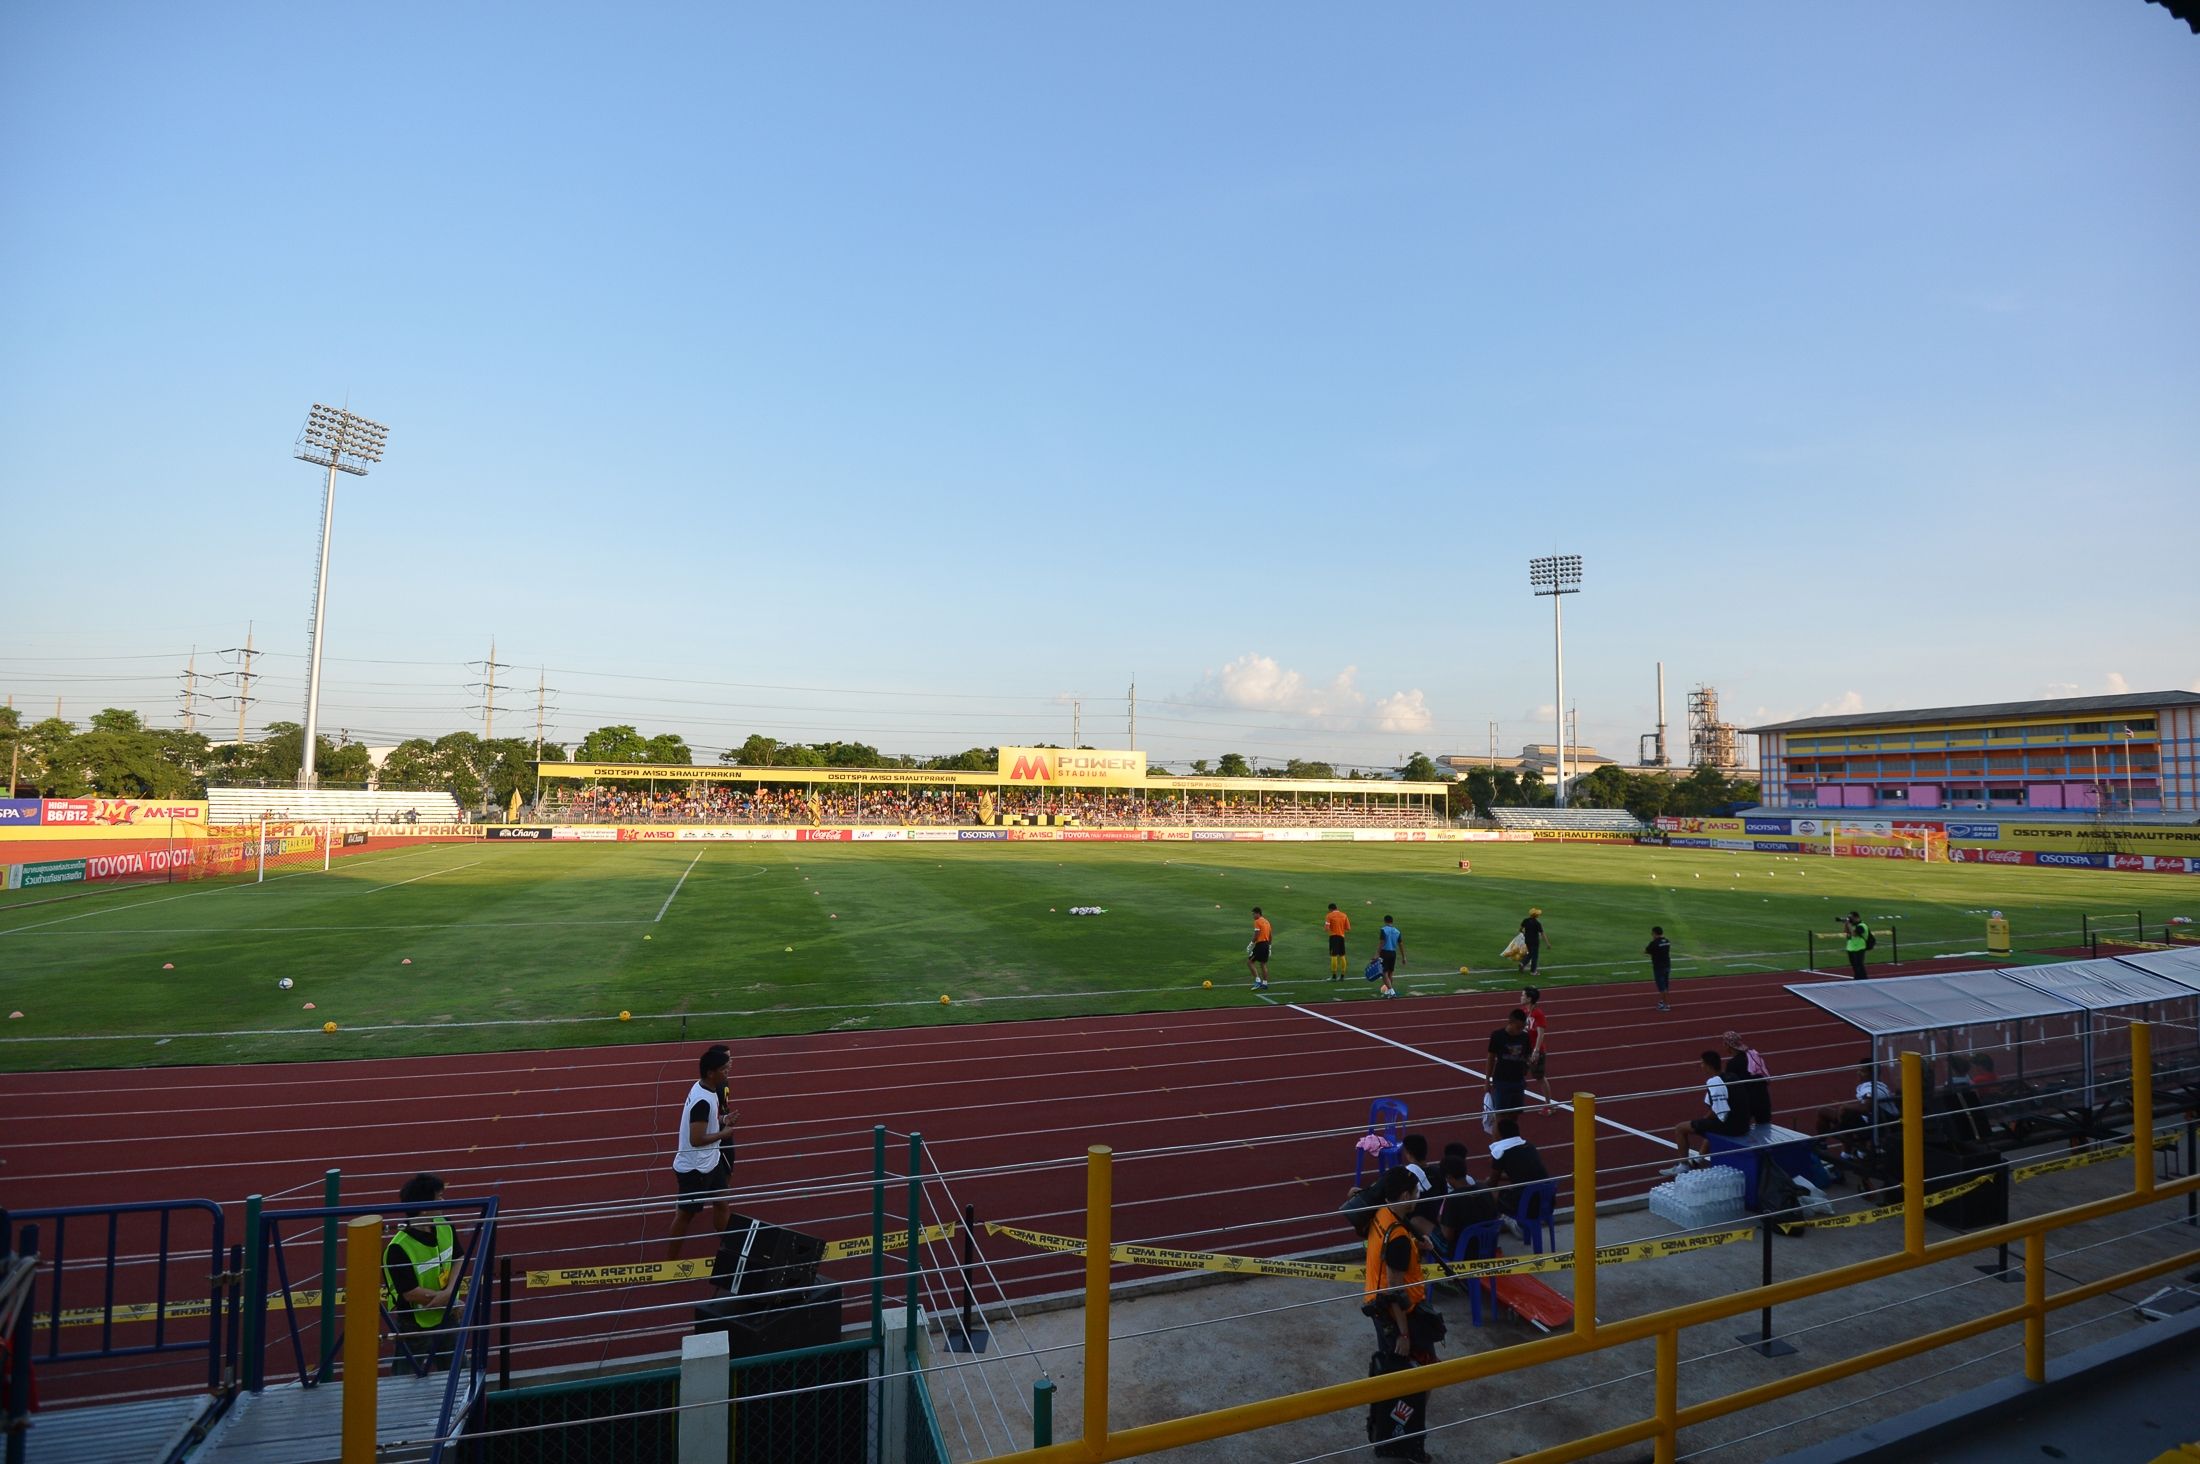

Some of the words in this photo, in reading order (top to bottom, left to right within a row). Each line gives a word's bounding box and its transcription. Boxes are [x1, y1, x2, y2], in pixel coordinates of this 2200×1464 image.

[1058, 757, 1136, 770] POWER
[594, 768, 639, 776] OSOTSPA
[670, 770, 742, 778] SAMUTPRAKAN
[47, 810, 88, 821] B6/B12
[511, 828, 539, 838] Chang
[961, 831, 996, 839] OSOTSPA
[2013, 829, 2072, 838] OSOTSPA
[1855, 845, 1904, 857] TOYOTA
[150, 848, 195, 869] TOYOTA
[2040, 854, 2090, 865] OSOTSPA
[89, 854, 143, 877] TOYOTA
